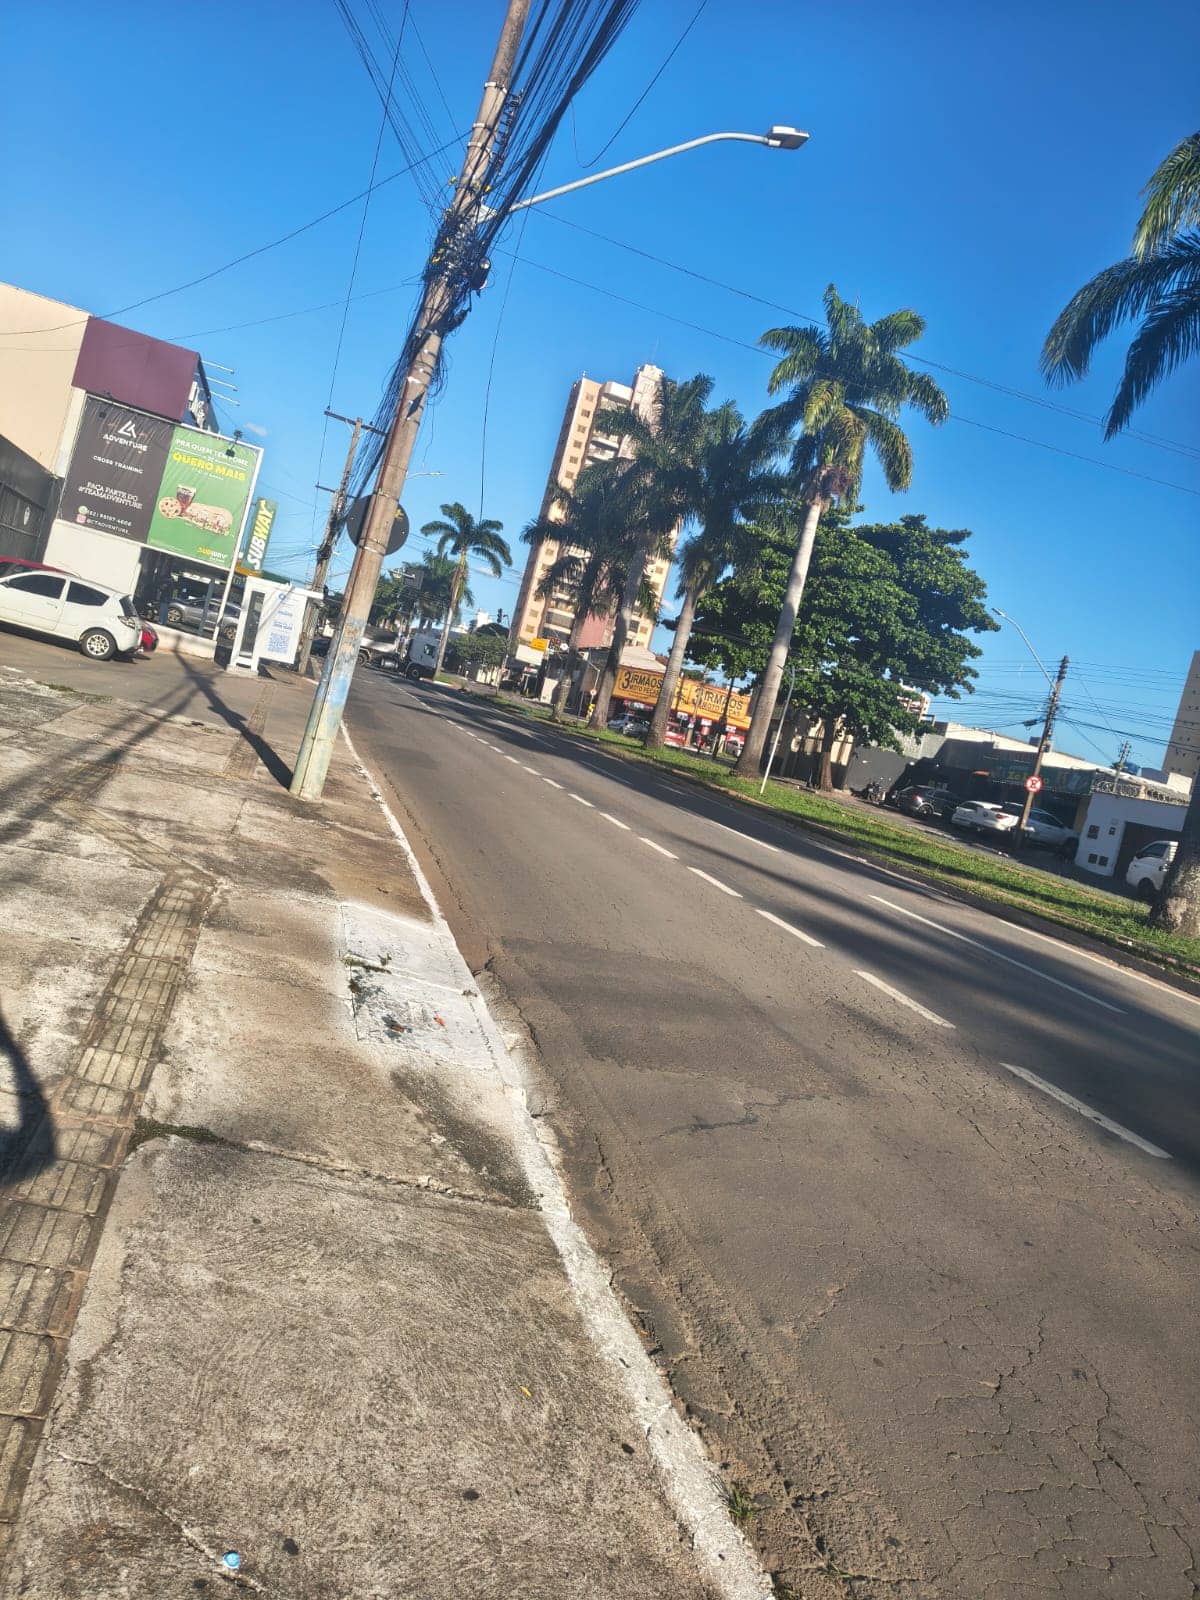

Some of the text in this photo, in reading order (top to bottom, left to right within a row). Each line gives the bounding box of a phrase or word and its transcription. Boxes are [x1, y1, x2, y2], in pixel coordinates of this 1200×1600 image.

[103, 434, 148, 451] ADVENTURE
[176, 439, 190, 448] PRA
[191, 443, 212, 454] QUEM
[93, 456, 144, 474] CROSS TRAINING
[172, 451, 213, 471] QUERO
[215, 465, 246, 481] MAIS
[105, 487, 127, 498] PARTE
[127, 493, 138, 502] DO
[247, 499, 274, 570] SUBWAY
[621, 671, 631, 689] 3
